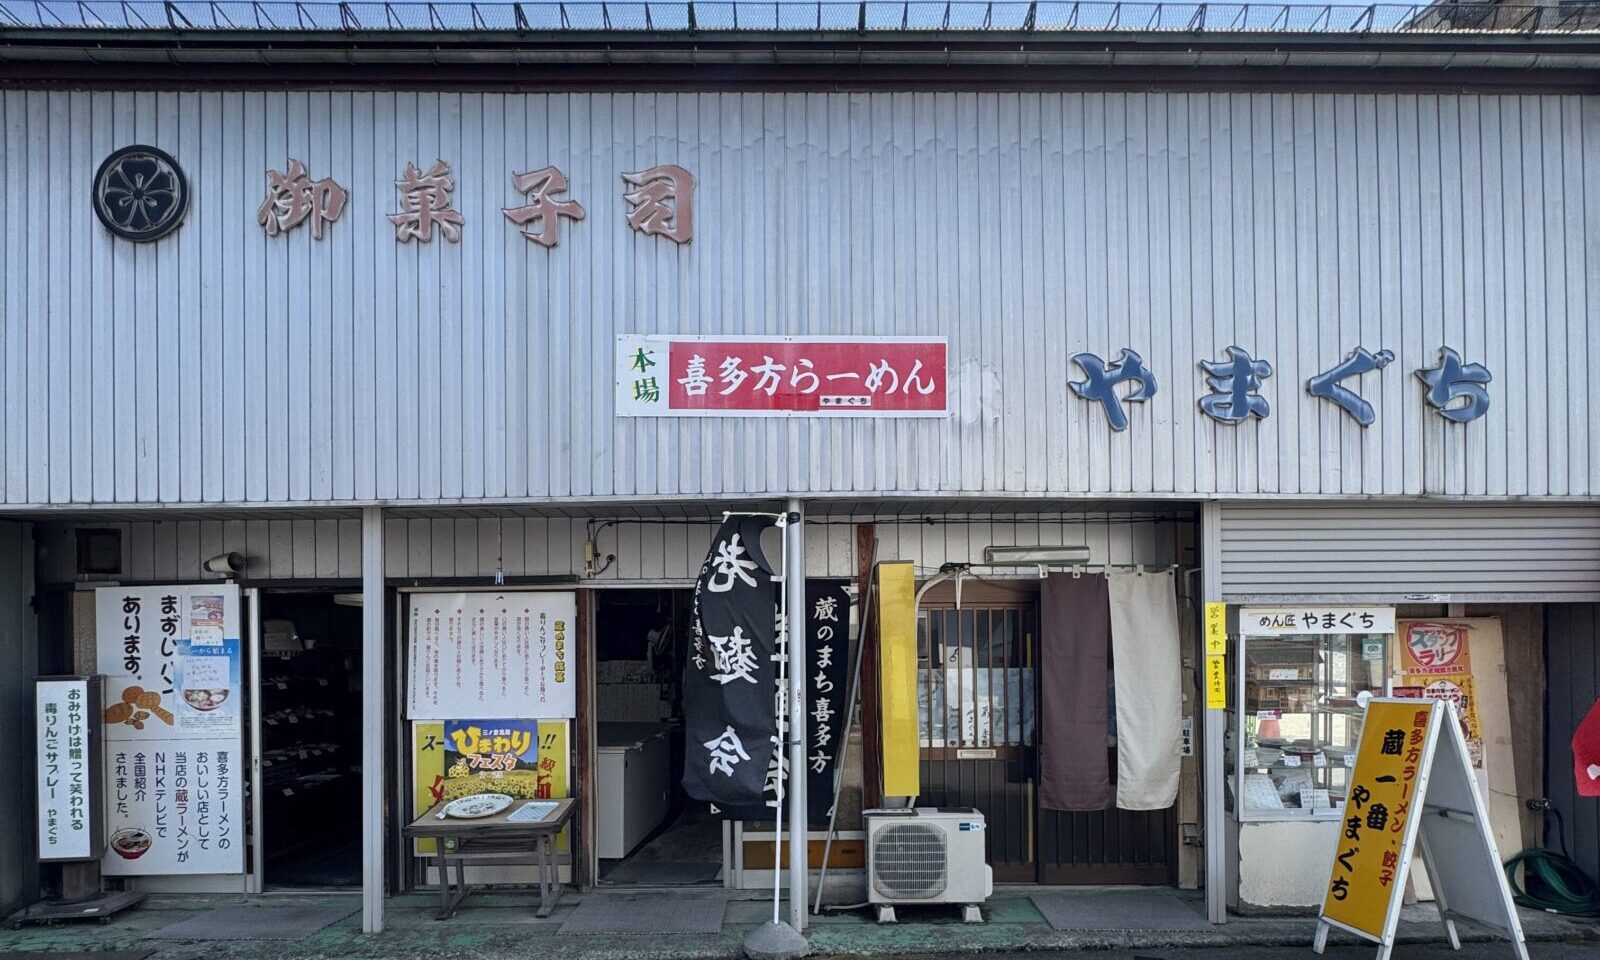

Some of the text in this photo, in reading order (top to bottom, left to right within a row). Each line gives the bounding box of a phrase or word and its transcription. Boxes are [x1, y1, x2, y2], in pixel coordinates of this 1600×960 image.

[258, 159, 696, 246] 御菓子司
[628, 347, 660, 405] 本場
[677, 353, 935, 397] 喜多方らーめん
[1067, 345, 1492, 431] やまぐち
[122, 596, 142, 681] あります。
[1259, 612, 1375, 629] めん匠 やまぐち
[808, 596, 838, 774] 蔵のまち喜多方
[134, 752, 146, 802] 全国紹介
[451, 726, 531, 757] ひまわり
[467, 753, 517, 772] フェスタ
[1366, 729, 1406, 831] 蔵一番
[47, 808, 58, 845] やまぐち
[115, 752, 129, 818] されました。
[155, 752, 167, 838] NHKテレビで
[175, 751, 189, 863] 当店の蔵ラーメンが
[196, 751, 209, 850] おいしい店として
[216, 751, 231, 850] 喜多方ラーメンの
[1331, 784, 1371, 901] やまぐち
